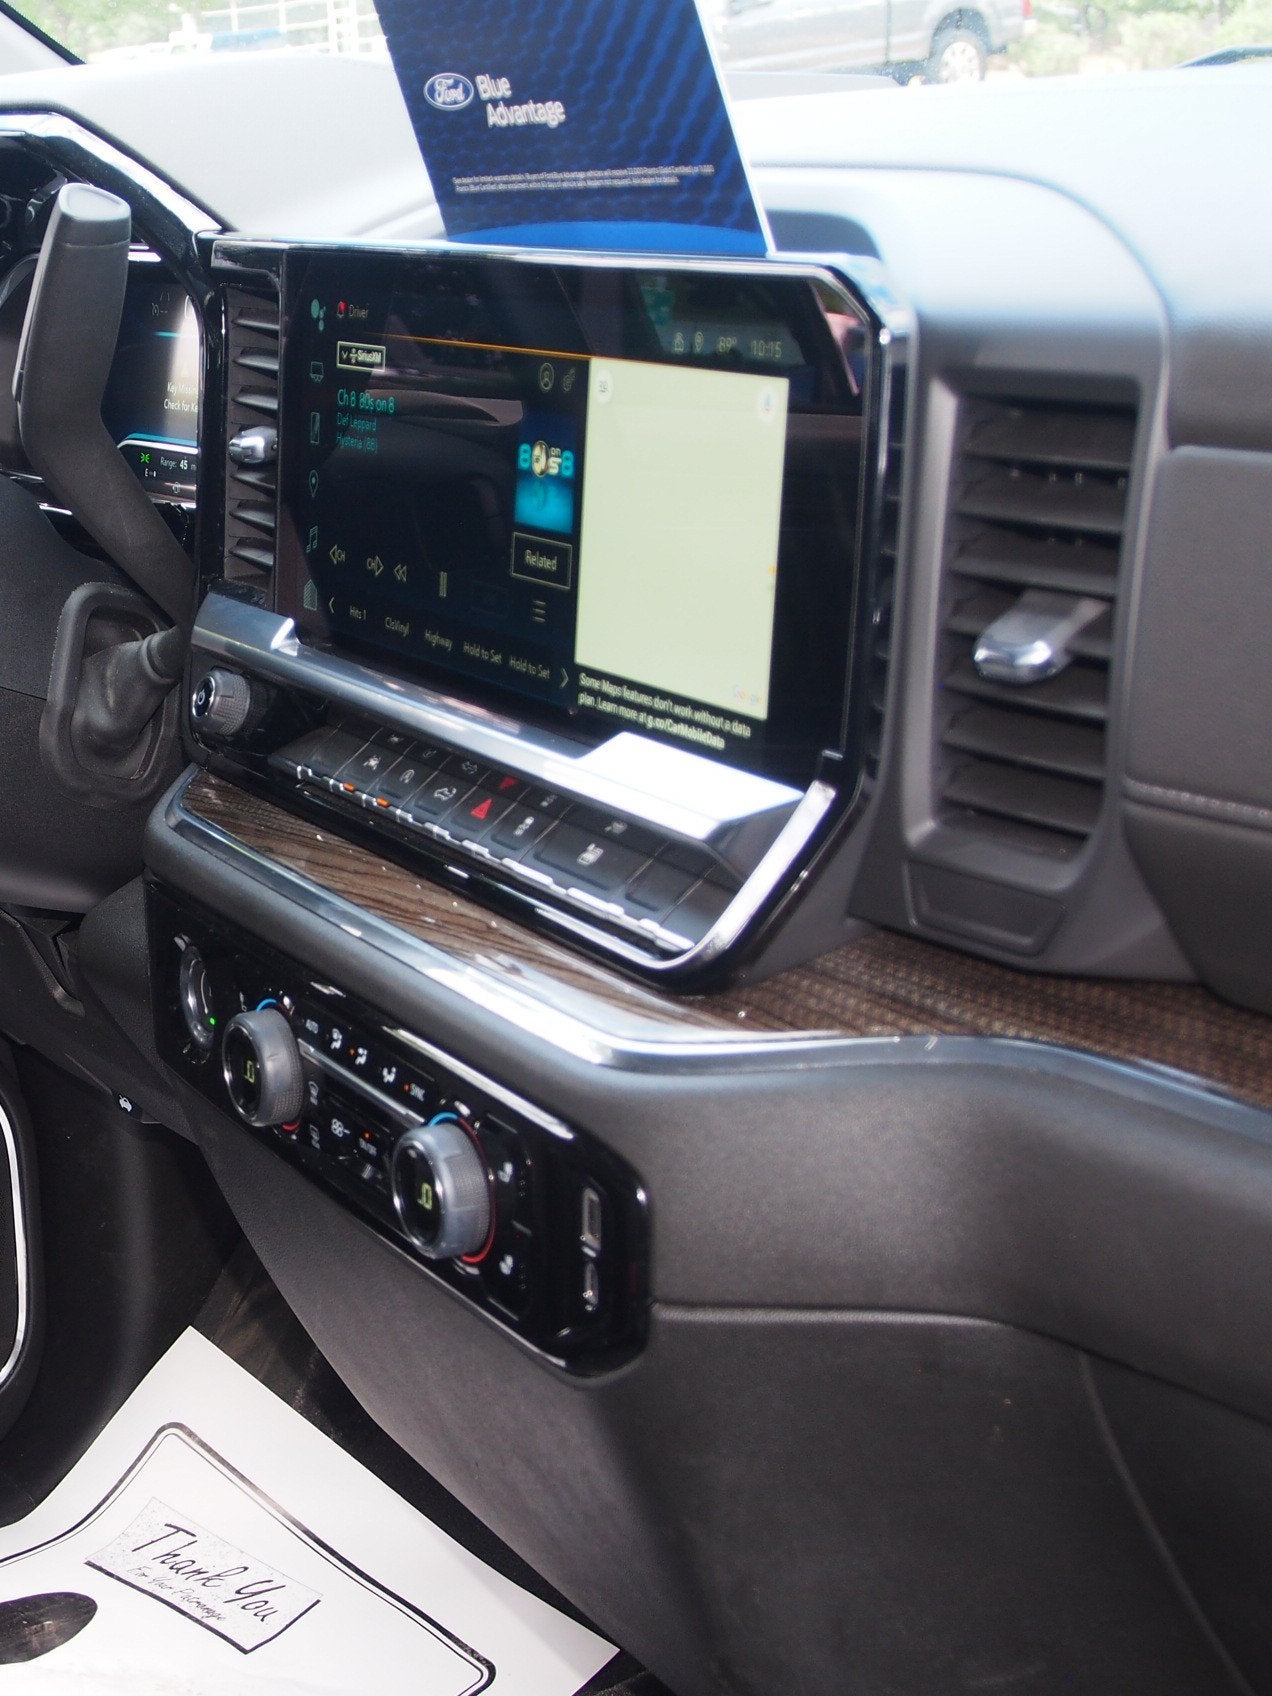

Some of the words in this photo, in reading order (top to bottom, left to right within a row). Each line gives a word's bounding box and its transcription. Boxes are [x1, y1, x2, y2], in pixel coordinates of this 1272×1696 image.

[434, 78, 466, 105] Ford
[475, 73, 512, 101] Blue
[486, 100, 566, 129] Advantage
[348, 305, 369, 319] Driver
[357, 350, 382, 363] SiriusXM
[163, 399, 180, 411] Check
[181, 401, 190, 412] for
[337, 389, 349, 405] Ch
[350, 391, 356, 407] 8
[359, 392, 374, 410] 80s
[375, 398, 387, 412] on
[388, 397, 395, 414] 8
[337, 412, 349, 426] Def
[350, 414, 377, 432] Leppard
[180, 459, 188, 470] 45
[525, 549, 558, 572] Related
[424, 629, 453, 651] Highway
[463, 641, 480, 657] Hold
[481, 649, 489, 660] to
[490, 650, 503, 664] Set
[509, 656, 527, 672] Hold
[528, 663, 537, 675] to
[538, 665, 551, 680] Set
[579, 673, 600, 690] Some
[601, 679, 622, 697] Maps
[622, 685, 653, 706] features
[653, 696, 673, 713] don't
[673, 705, 693, 720] work
[694, 710, 724, 730] without
[732, 721, 751, 738] data
[596, 697, 618, 714] Learn
[618, 706, 638, 721] more
[638, 712, 647, 724] at
[131, 1523, 249, 1588] Thank
[223, 1579, 286, 1622] You
